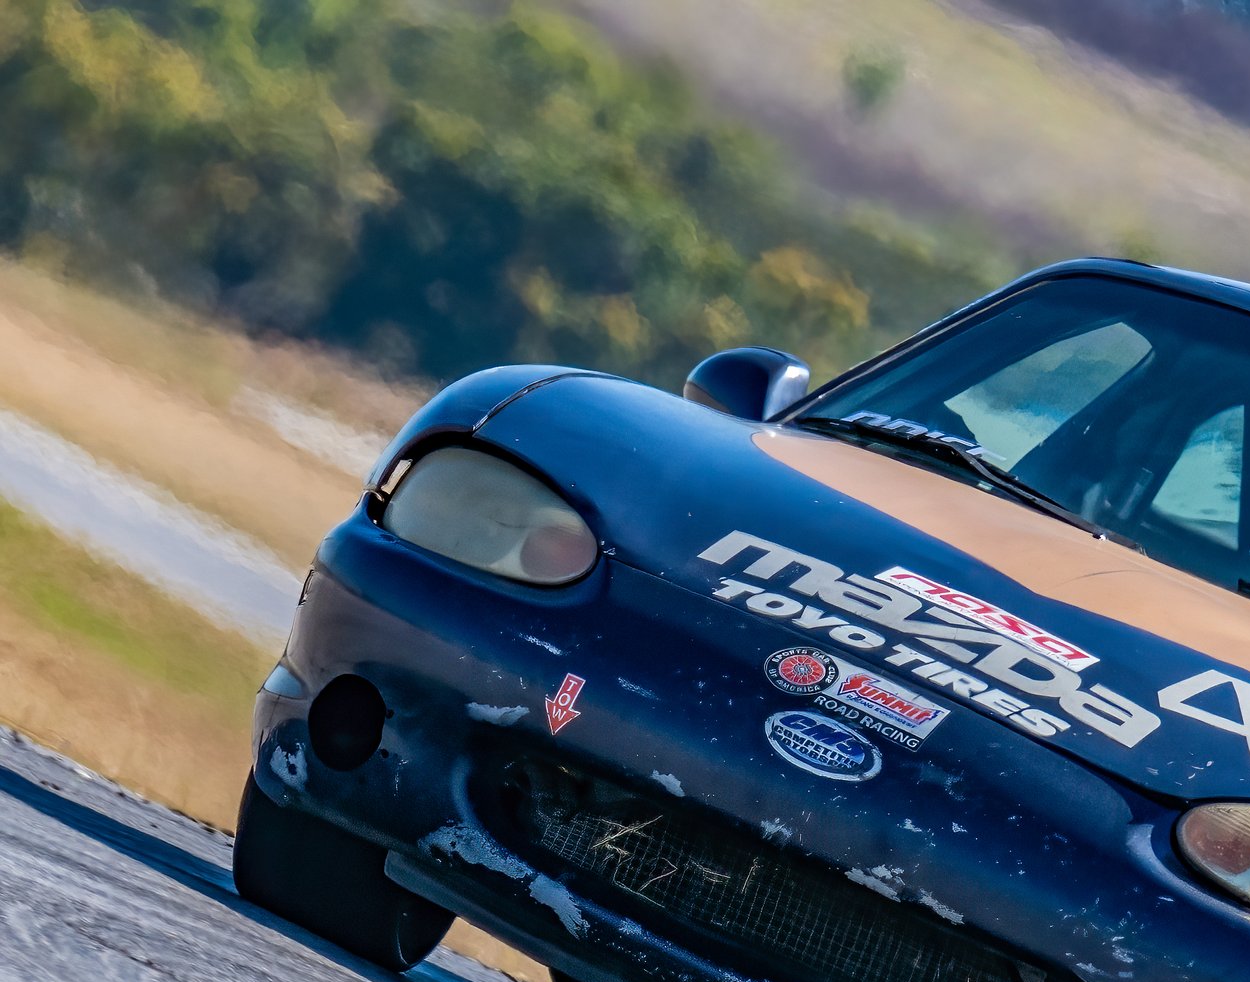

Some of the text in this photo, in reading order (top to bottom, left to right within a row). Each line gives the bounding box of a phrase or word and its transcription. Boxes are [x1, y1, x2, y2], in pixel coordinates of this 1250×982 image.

[714, 578, 886, 650] TOYO
[884, 643, 1071, 738] TIRES
[553, 680, 578, 721] TOW
[776, 679, 821, 693] AMERICA
[843, 673, 937, 724] SUMMIT
[814, 695, 921, 748] ROAD RACING
